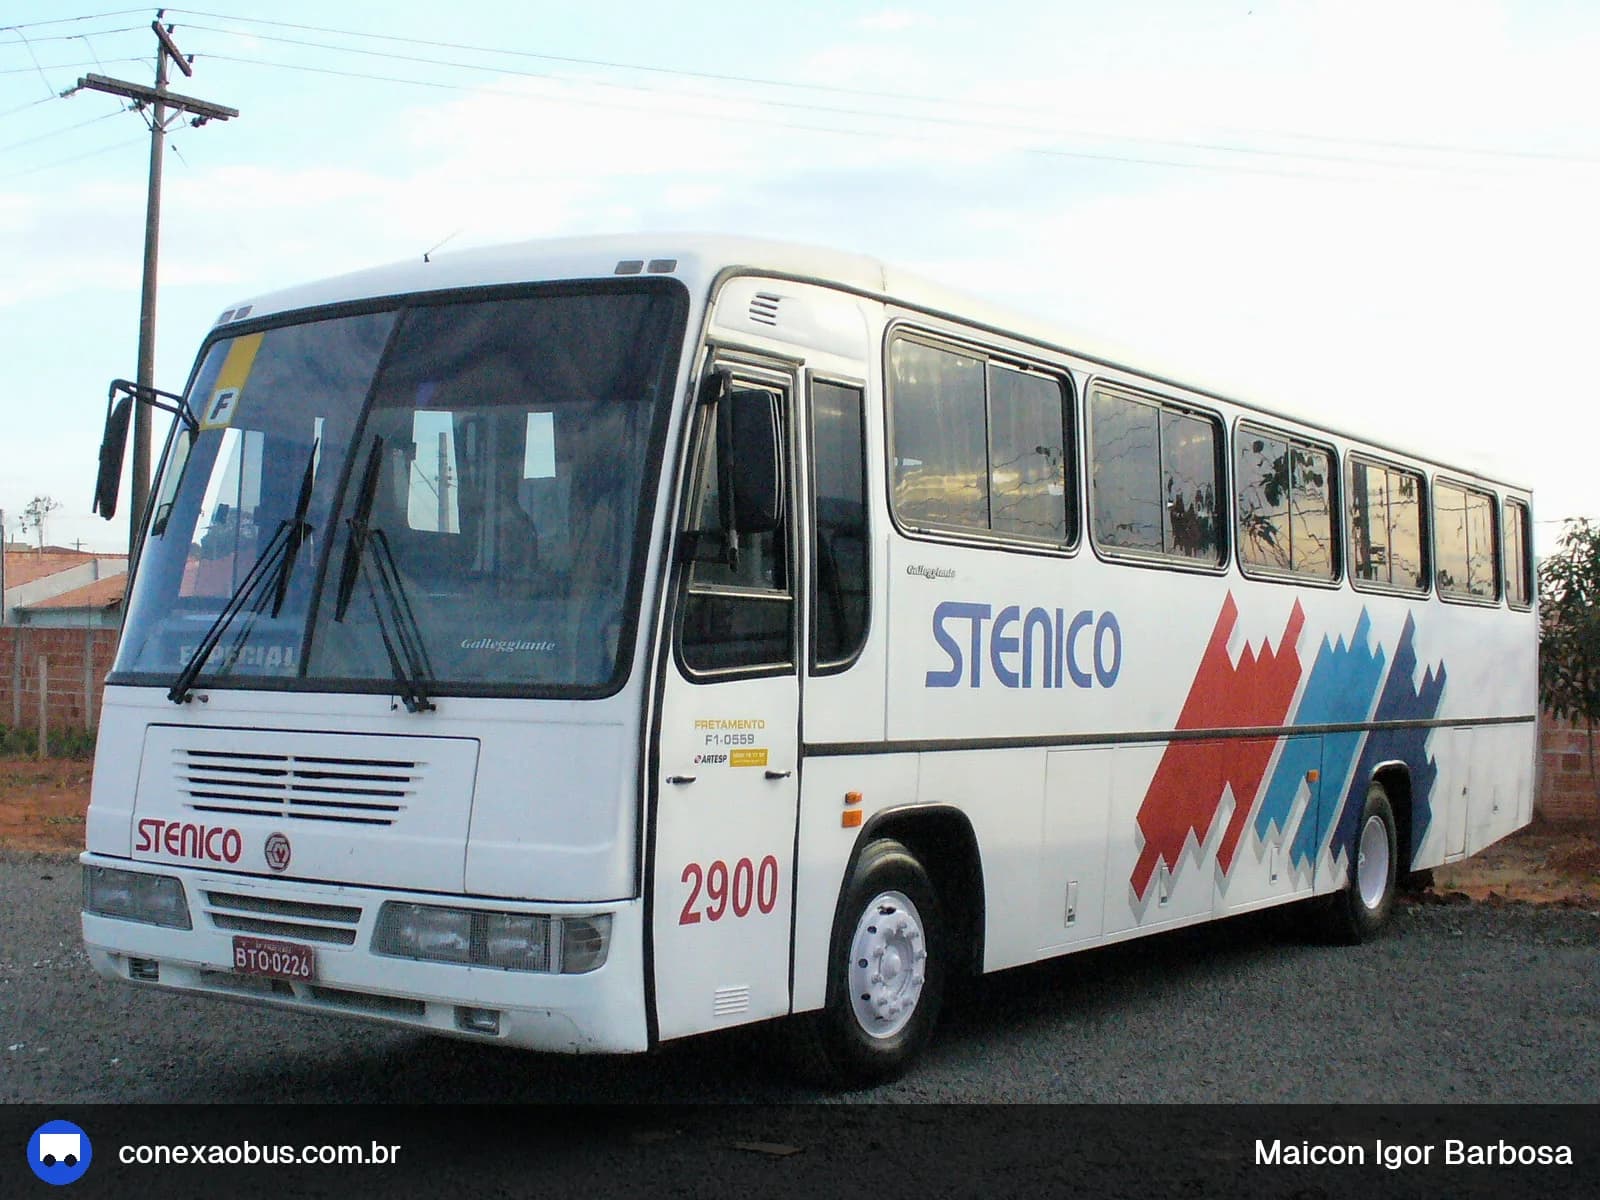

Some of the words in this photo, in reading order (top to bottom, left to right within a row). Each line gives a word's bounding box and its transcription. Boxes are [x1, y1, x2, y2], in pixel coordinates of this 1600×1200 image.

[210, 392, 234, 419] F
[179, 645, 296, 667] EPCIAL
[461, 638, 556, 653] Galleggiante
[925, 601, 1122, 689] STENICO
[694, 719, 765, 730] FRETAMENTO
[704, 733, 755, 746] F1-0559
[701, 754, 728, 764] ARTESP
[136, 819, 242, 864] STENICO
[679, 855, 779, 925] 2900
